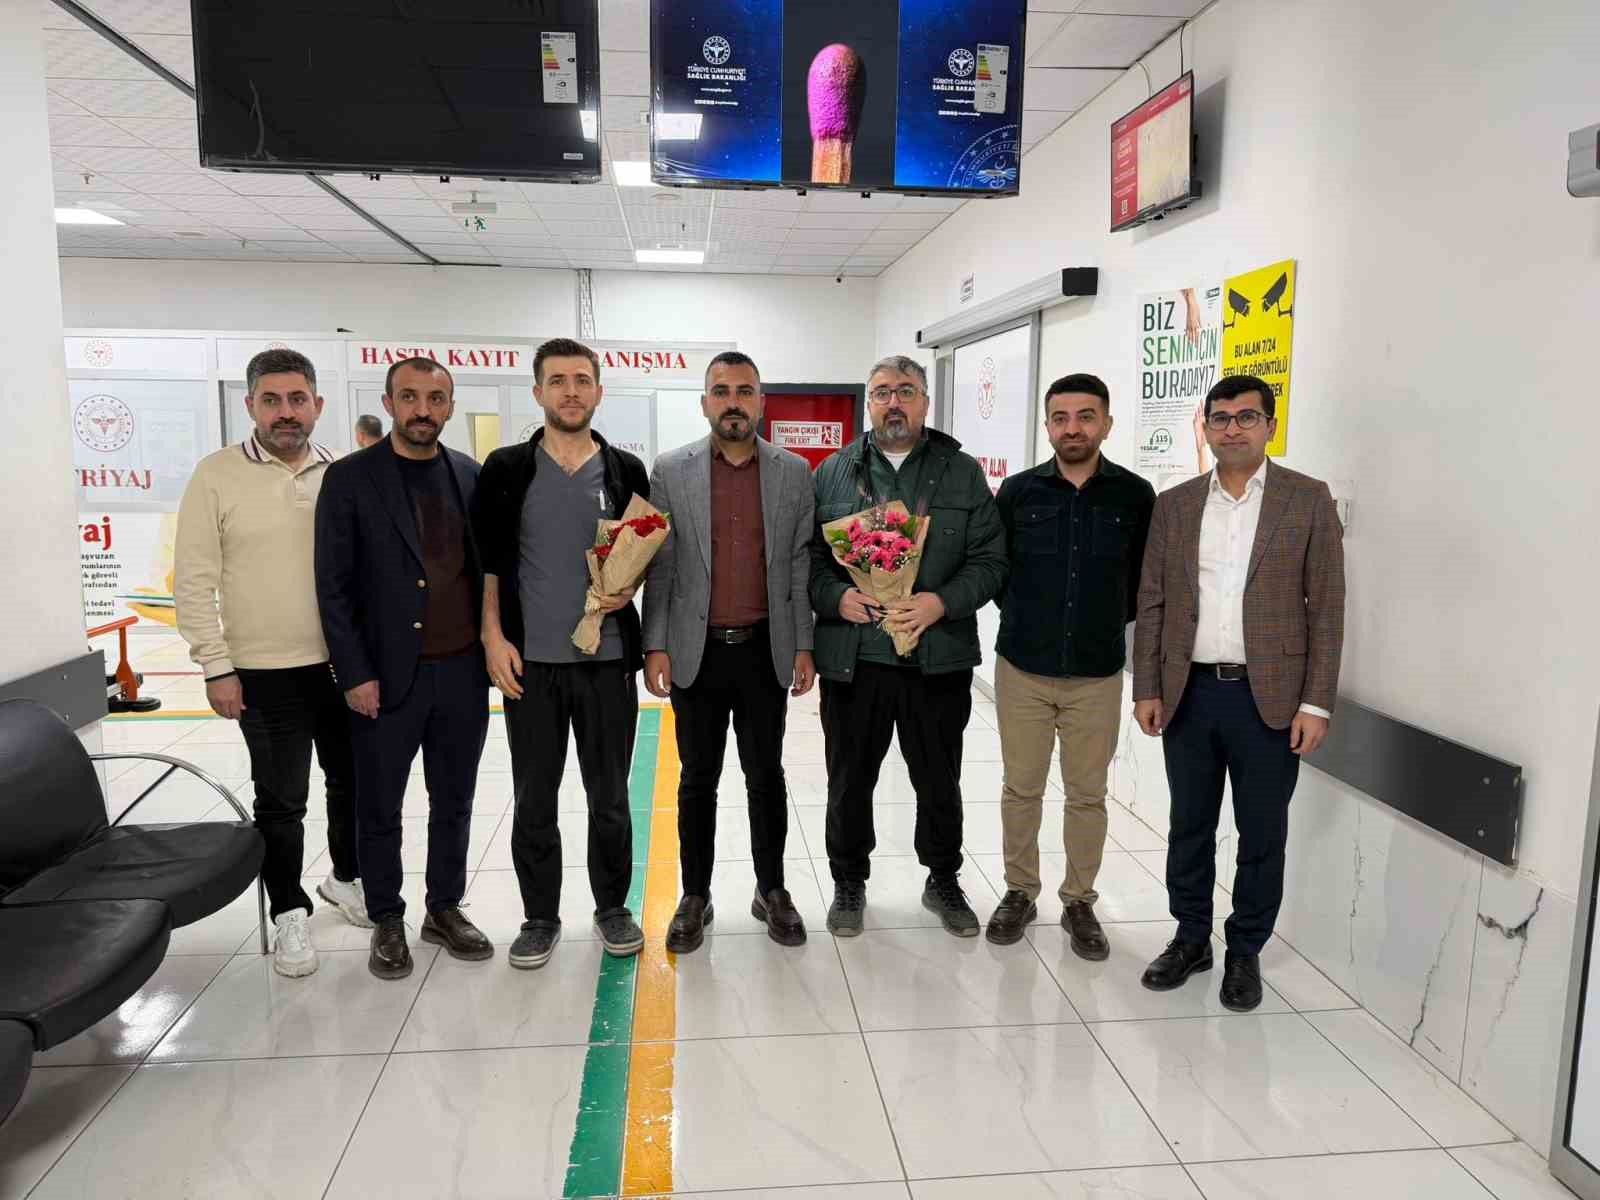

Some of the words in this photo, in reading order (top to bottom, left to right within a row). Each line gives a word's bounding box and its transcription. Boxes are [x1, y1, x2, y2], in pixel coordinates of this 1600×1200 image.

[1143, 297, 1175, 332] BİZ
[1234, 343, 1243, 358] BU
[1244, 340, 1261, 356] ALAN
[1262, 337, 1276, 353] 7/24
[448, 350, 519, 368] KAYIT
[1248, 355, 1288, 377] GÖRÜNTÜLÜ
[1142, 364, 1215, 400] BURADAYIZ
[989, 457, 1008, 477] ALAN
